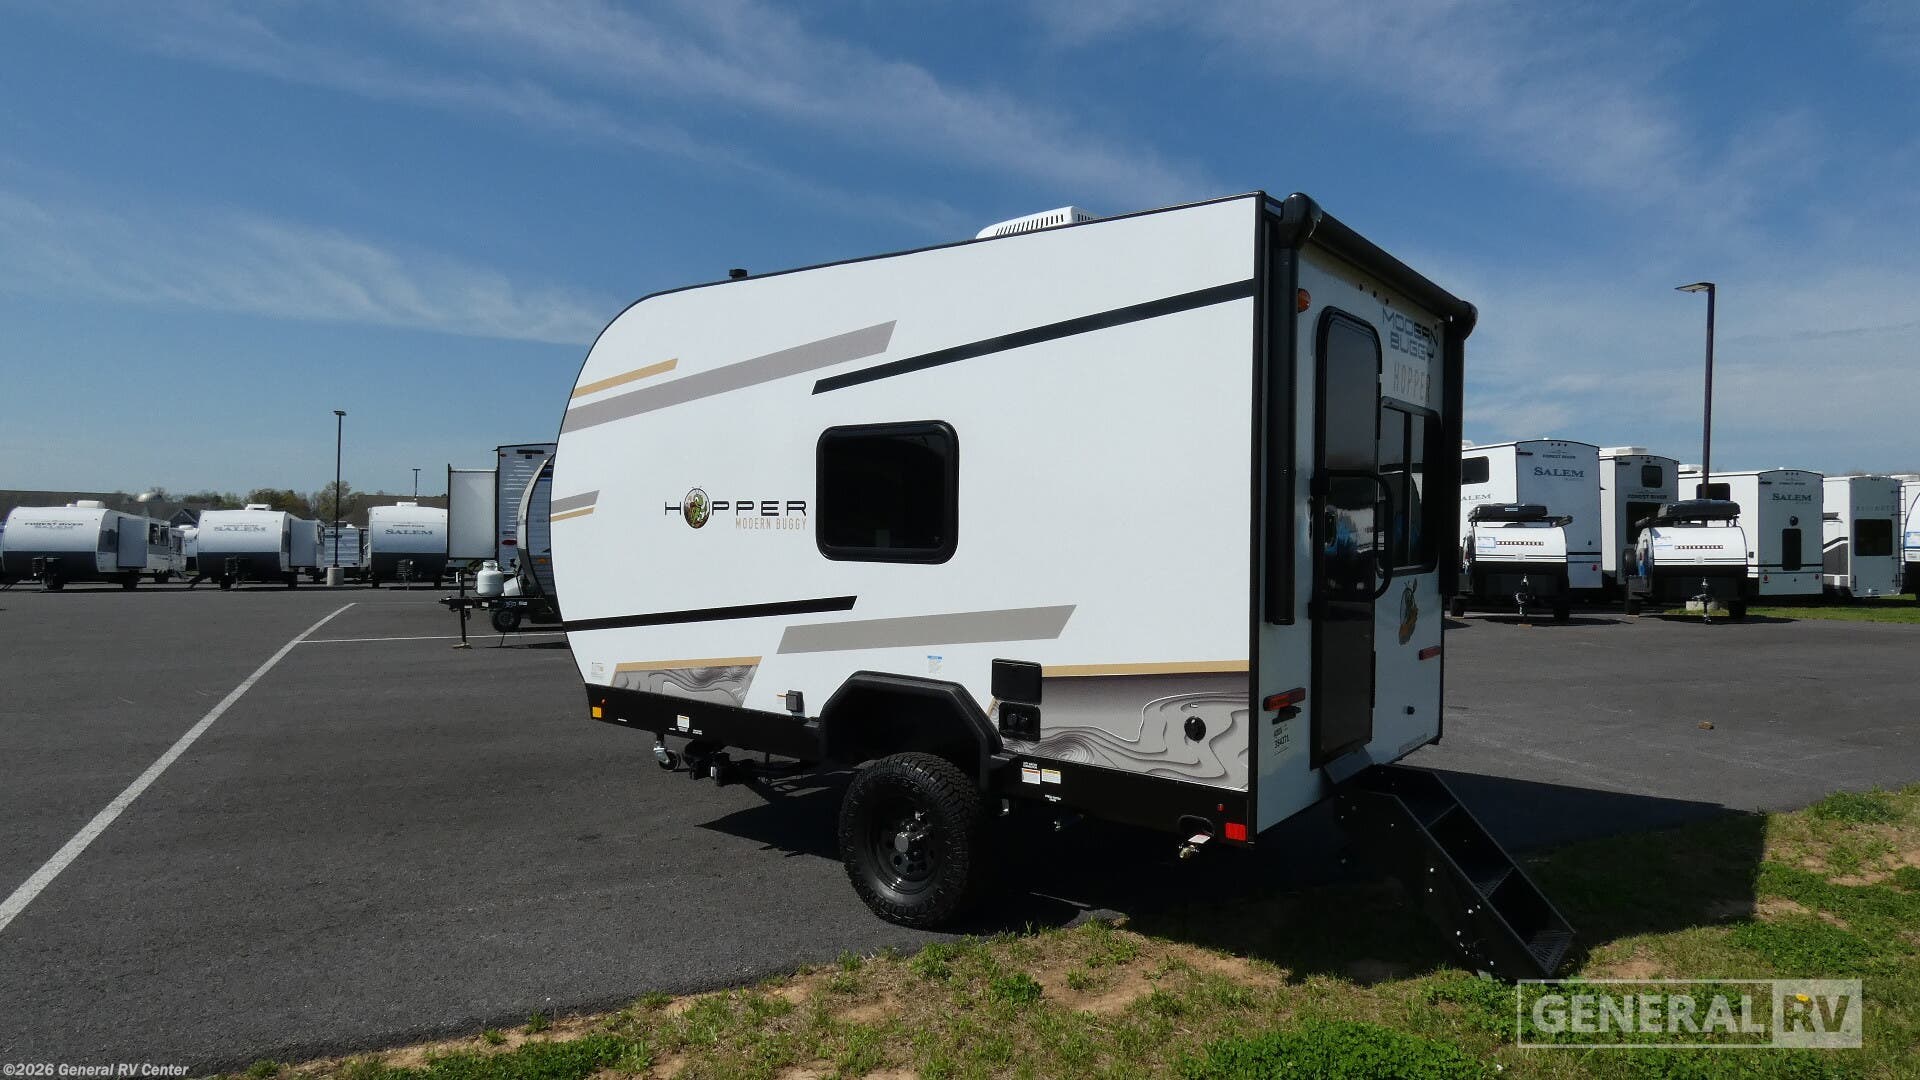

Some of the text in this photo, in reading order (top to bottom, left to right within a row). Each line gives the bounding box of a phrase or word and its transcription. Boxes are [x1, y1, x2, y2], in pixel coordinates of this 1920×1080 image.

[1382, 304, 1438, 348] MODERN
[1390, 331, 1435, 361] BUGGY
[1534, 467, 1585, 478] SALEM
[1772, 493, 1812, 502] SALEM
[665, 488, 807, 529] HOPPER
[736, 518, 807, 531] MODERN BUGGY
